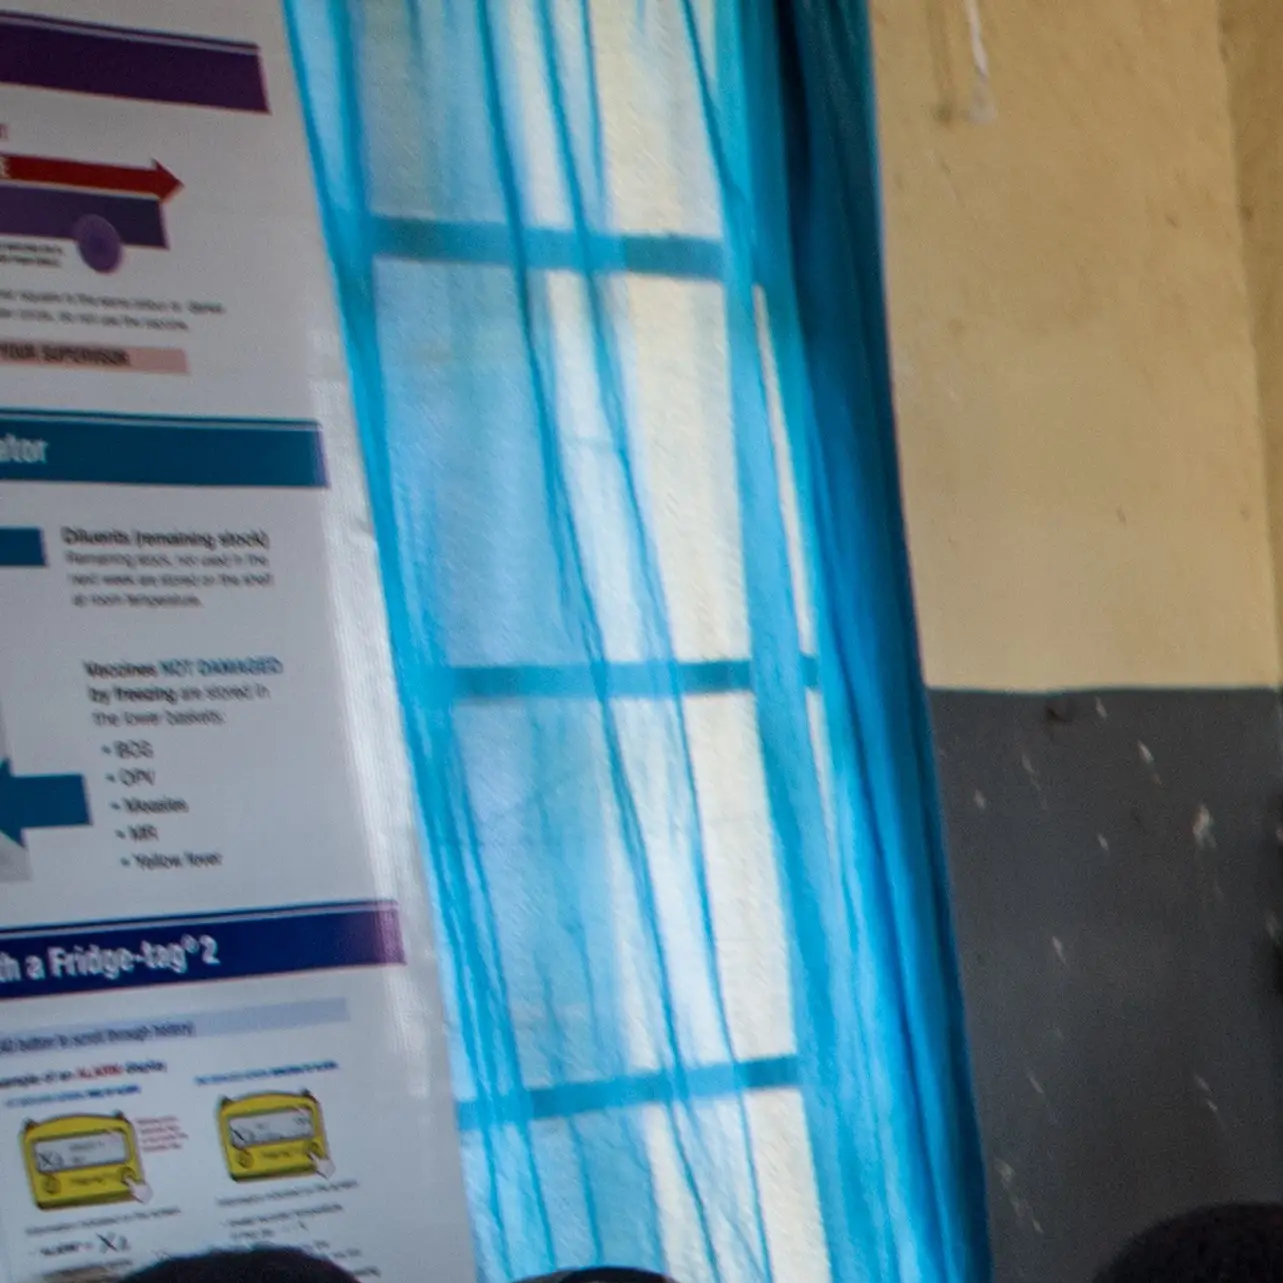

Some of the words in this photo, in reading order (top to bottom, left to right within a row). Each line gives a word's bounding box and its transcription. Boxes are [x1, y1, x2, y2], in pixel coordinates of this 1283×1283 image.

[42, 344, 131, 367] SUPERVISOR
[60, 526, 131, 546] Diluents
[132, 527, 216, 550] (remaining
[216, 528, 270, 550] stock)
[83, 660, 159, 679] Vaccines
[158, 658, 194, 677] NOT
[87, 686, 111, 705] by
[113, 685, 179, 705] freezing
[133, 852, 183, 872] Yellow
[25, 955, 46, 980] a
[199, 934, 221, 965] 2
